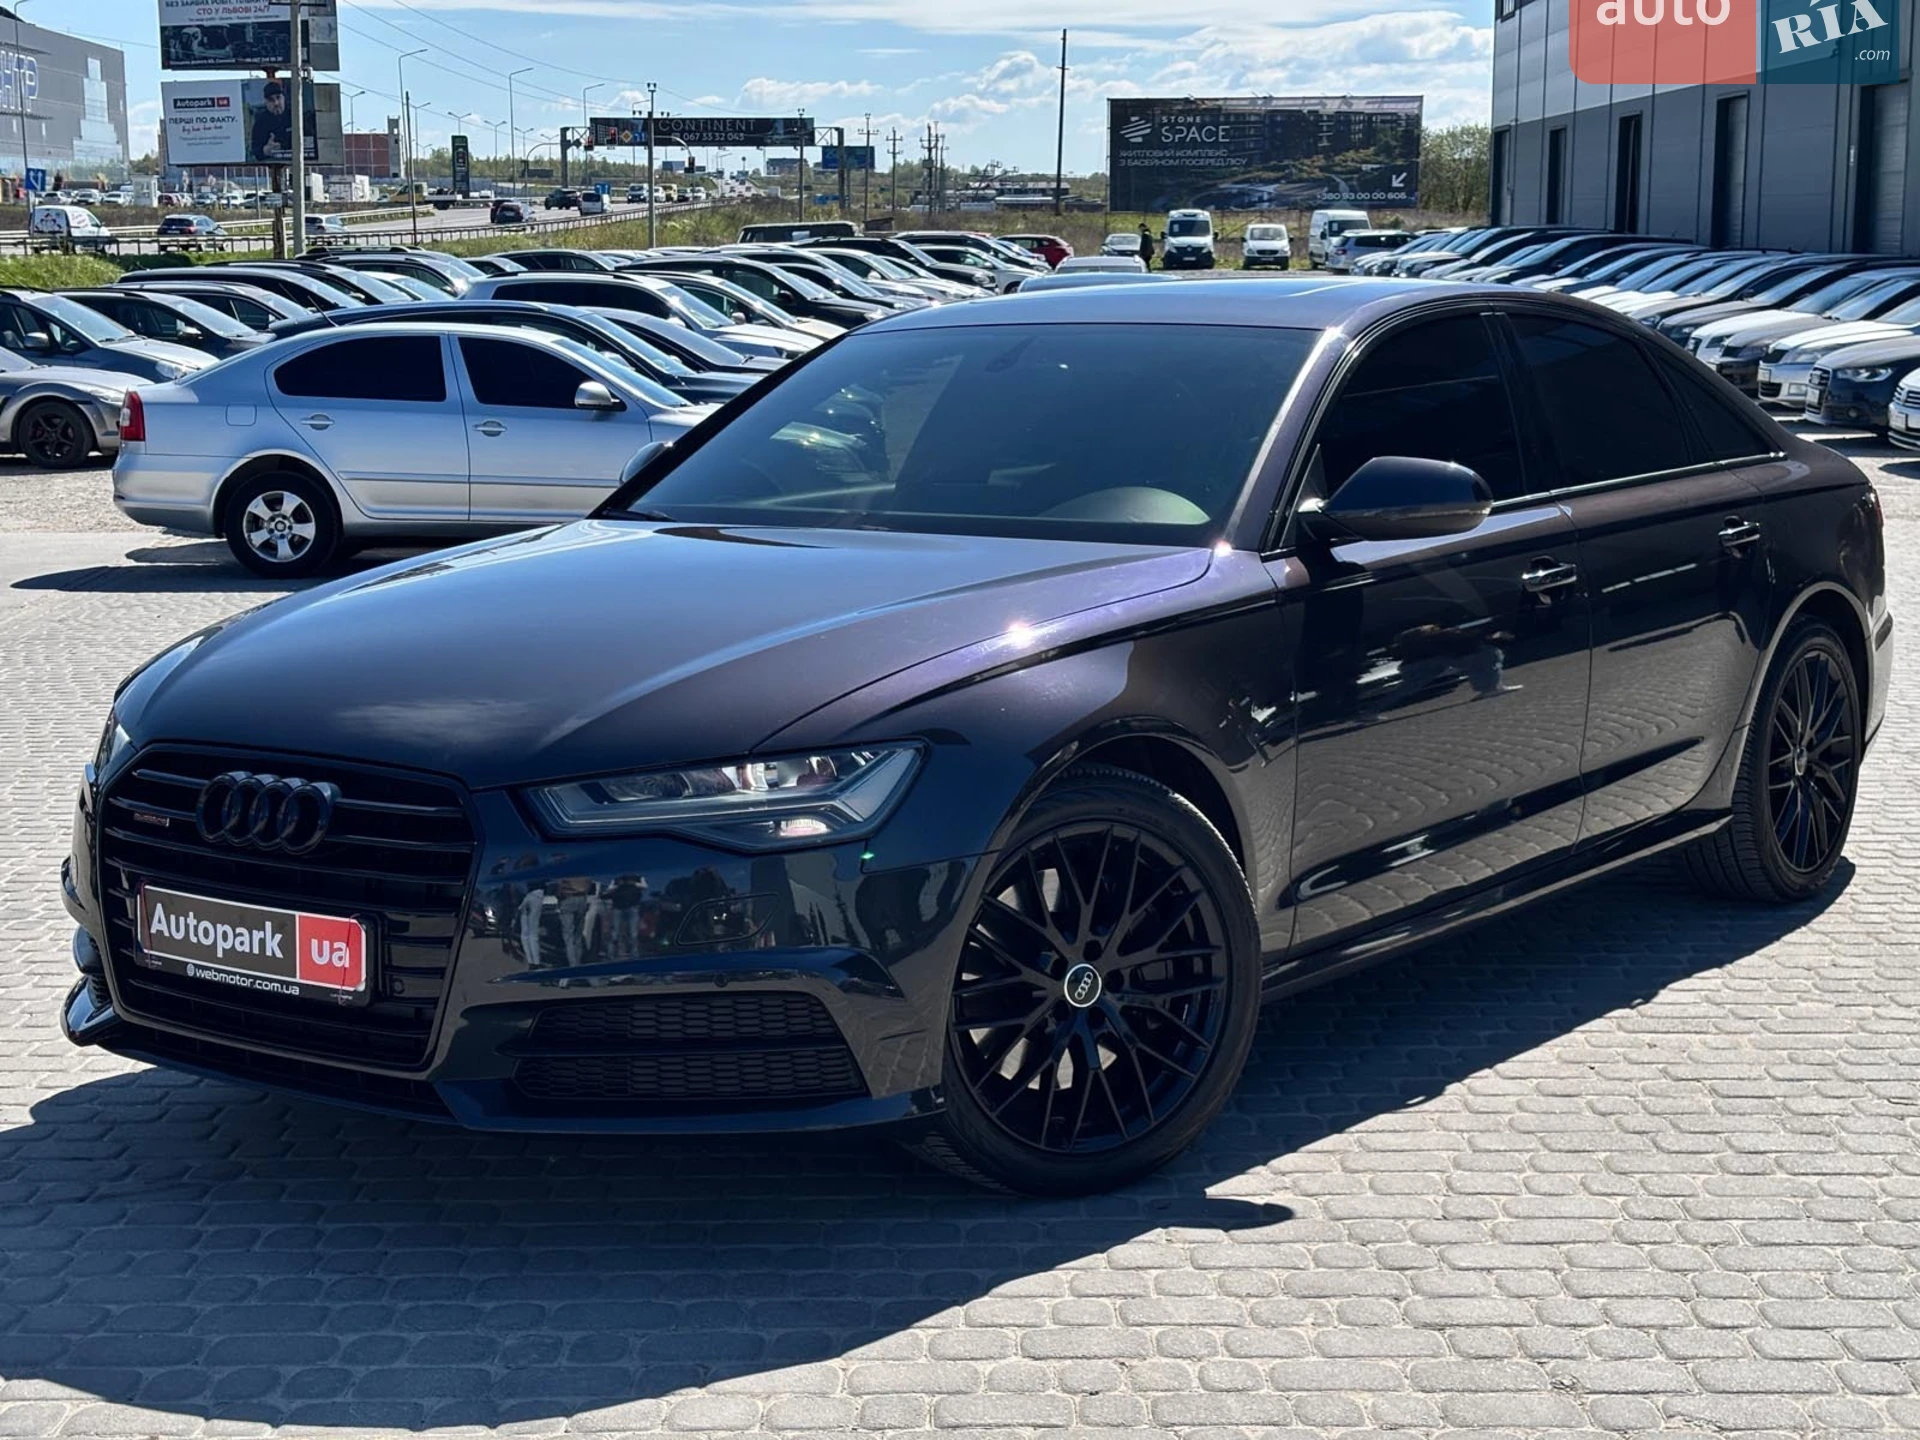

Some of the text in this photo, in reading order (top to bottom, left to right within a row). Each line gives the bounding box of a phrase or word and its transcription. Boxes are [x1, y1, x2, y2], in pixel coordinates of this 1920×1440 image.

[196, 5, 270, 16] СТО У ЛЬВОВІ 24/7
[175, 99, 214, 108] Autopark
[195, 116, 208, 124] ПО
[209, 115, 238, 123] ФАКТУ.
[1161, 115, 1201, 123] STONE
[659, 119, 757, 131] CONTINENT
[683, 132, 700, 141] 067
[1161, 125, 1230, 142] SPACE
[1356, 192, 1370, 200] 00
[1372, 192, 1386, 200] 00
[150, 903, 350, 968] Autopark ua
[196, 967, 300, 995] webmotor.com.ua
